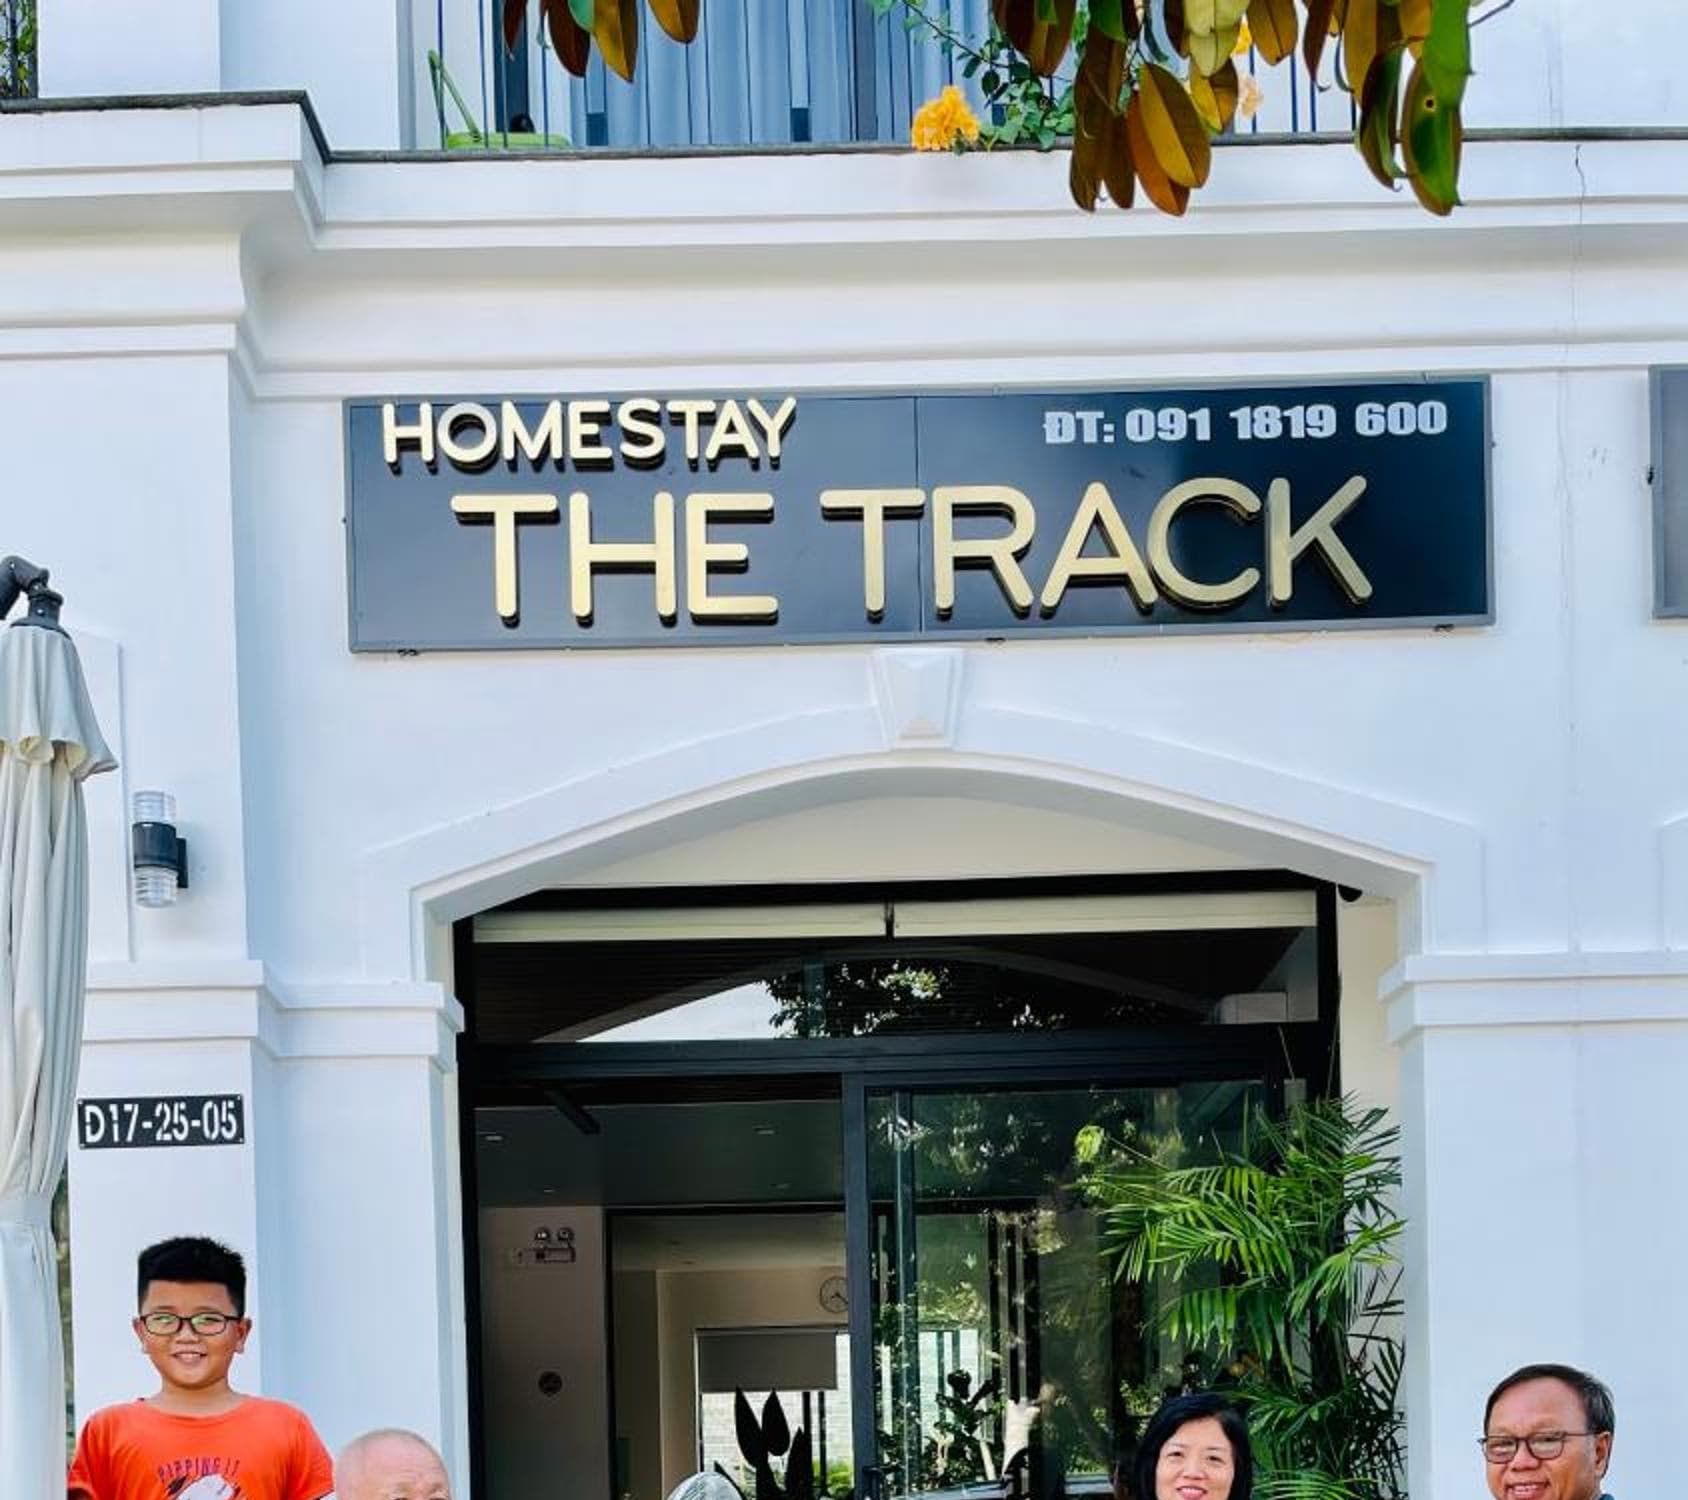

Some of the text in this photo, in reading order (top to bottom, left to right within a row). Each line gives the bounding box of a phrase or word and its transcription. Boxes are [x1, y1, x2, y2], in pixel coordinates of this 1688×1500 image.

[383, 397, 797, 470] HOMESTAY
[1043, 401, 1448, 444] ĐT: 091 1819 600
[451, 475, 1373, 624] THE TRACK
[84, 1100, 238, 1143] D17-25-05
